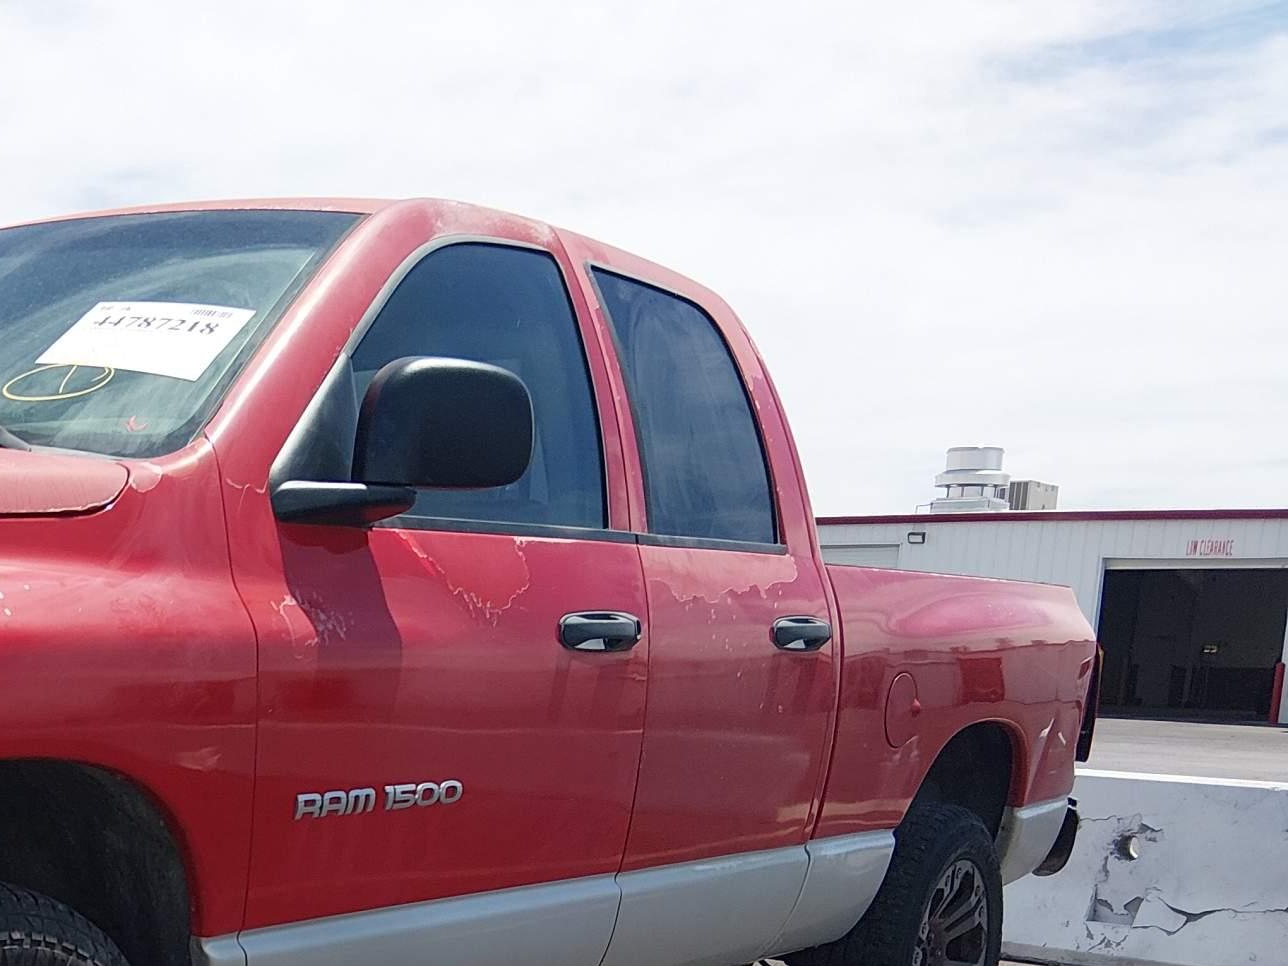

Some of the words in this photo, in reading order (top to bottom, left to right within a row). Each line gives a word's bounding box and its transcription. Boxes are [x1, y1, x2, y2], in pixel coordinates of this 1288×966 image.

[93, 316, 219, 335] 44787218
[1199, 540, 1234, 556] CLEARANCE
[295, 787, 376, 820] RAM
[384, 779, 463, 810] 1500
